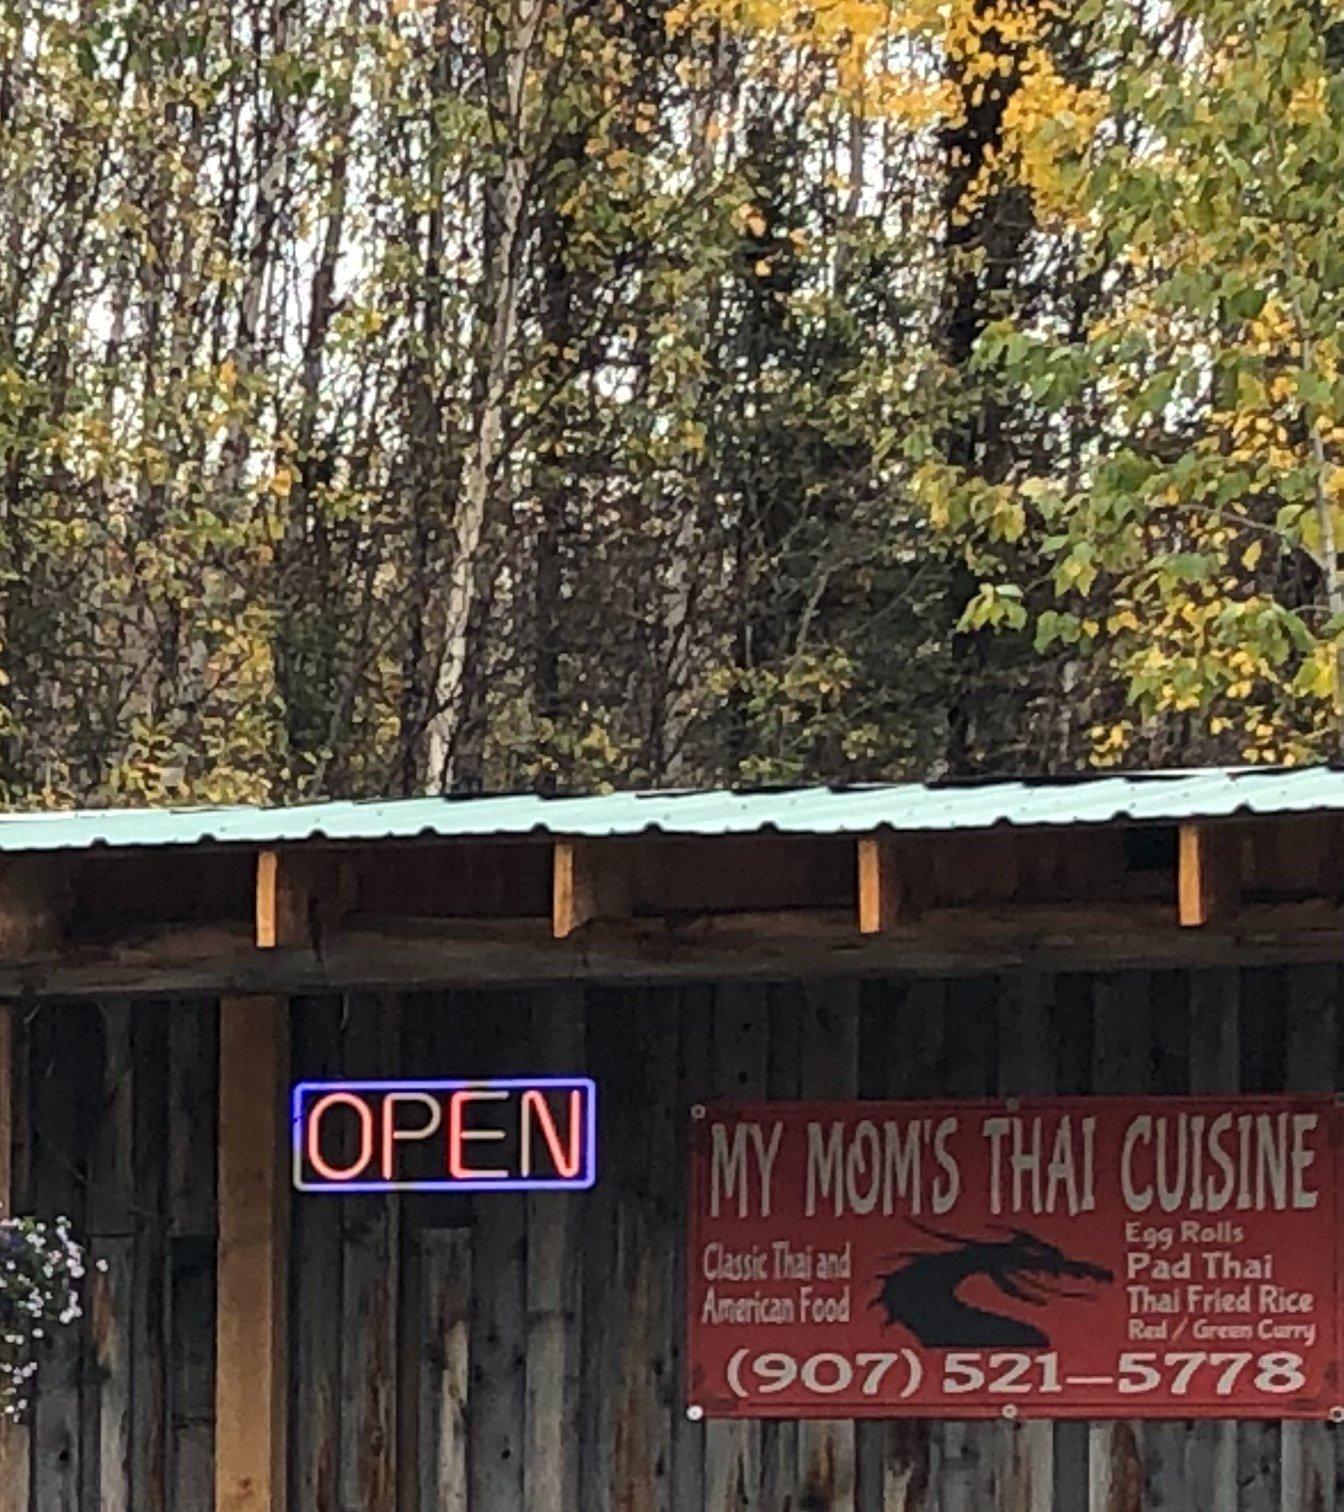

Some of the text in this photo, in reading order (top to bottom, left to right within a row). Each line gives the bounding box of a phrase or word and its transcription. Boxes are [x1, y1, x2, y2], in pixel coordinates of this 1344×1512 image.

[308, 1090, 581, 1181] OPEN
[710, 1111, 1320, 1220] MY MOM'S THAI CUISINE
[1125, 1220, 1244, 1251] Egg Rolls
[704, 1240, 851, 1281] Classic Thai and
[1127, 1251, 1273, 1280] Pad Thai
[702, 1285, 850, 1324] American Food
[1127, 1283, 1314, 1314] Thai Fried Rice
[1128, 1318, 1167, 1340] Red
[1193, 1318, 1253, 1341] Green
[1258, 1318, 1316, 1347] Curry
[727, 1349, 1307, 1398] (907) 521-5778
